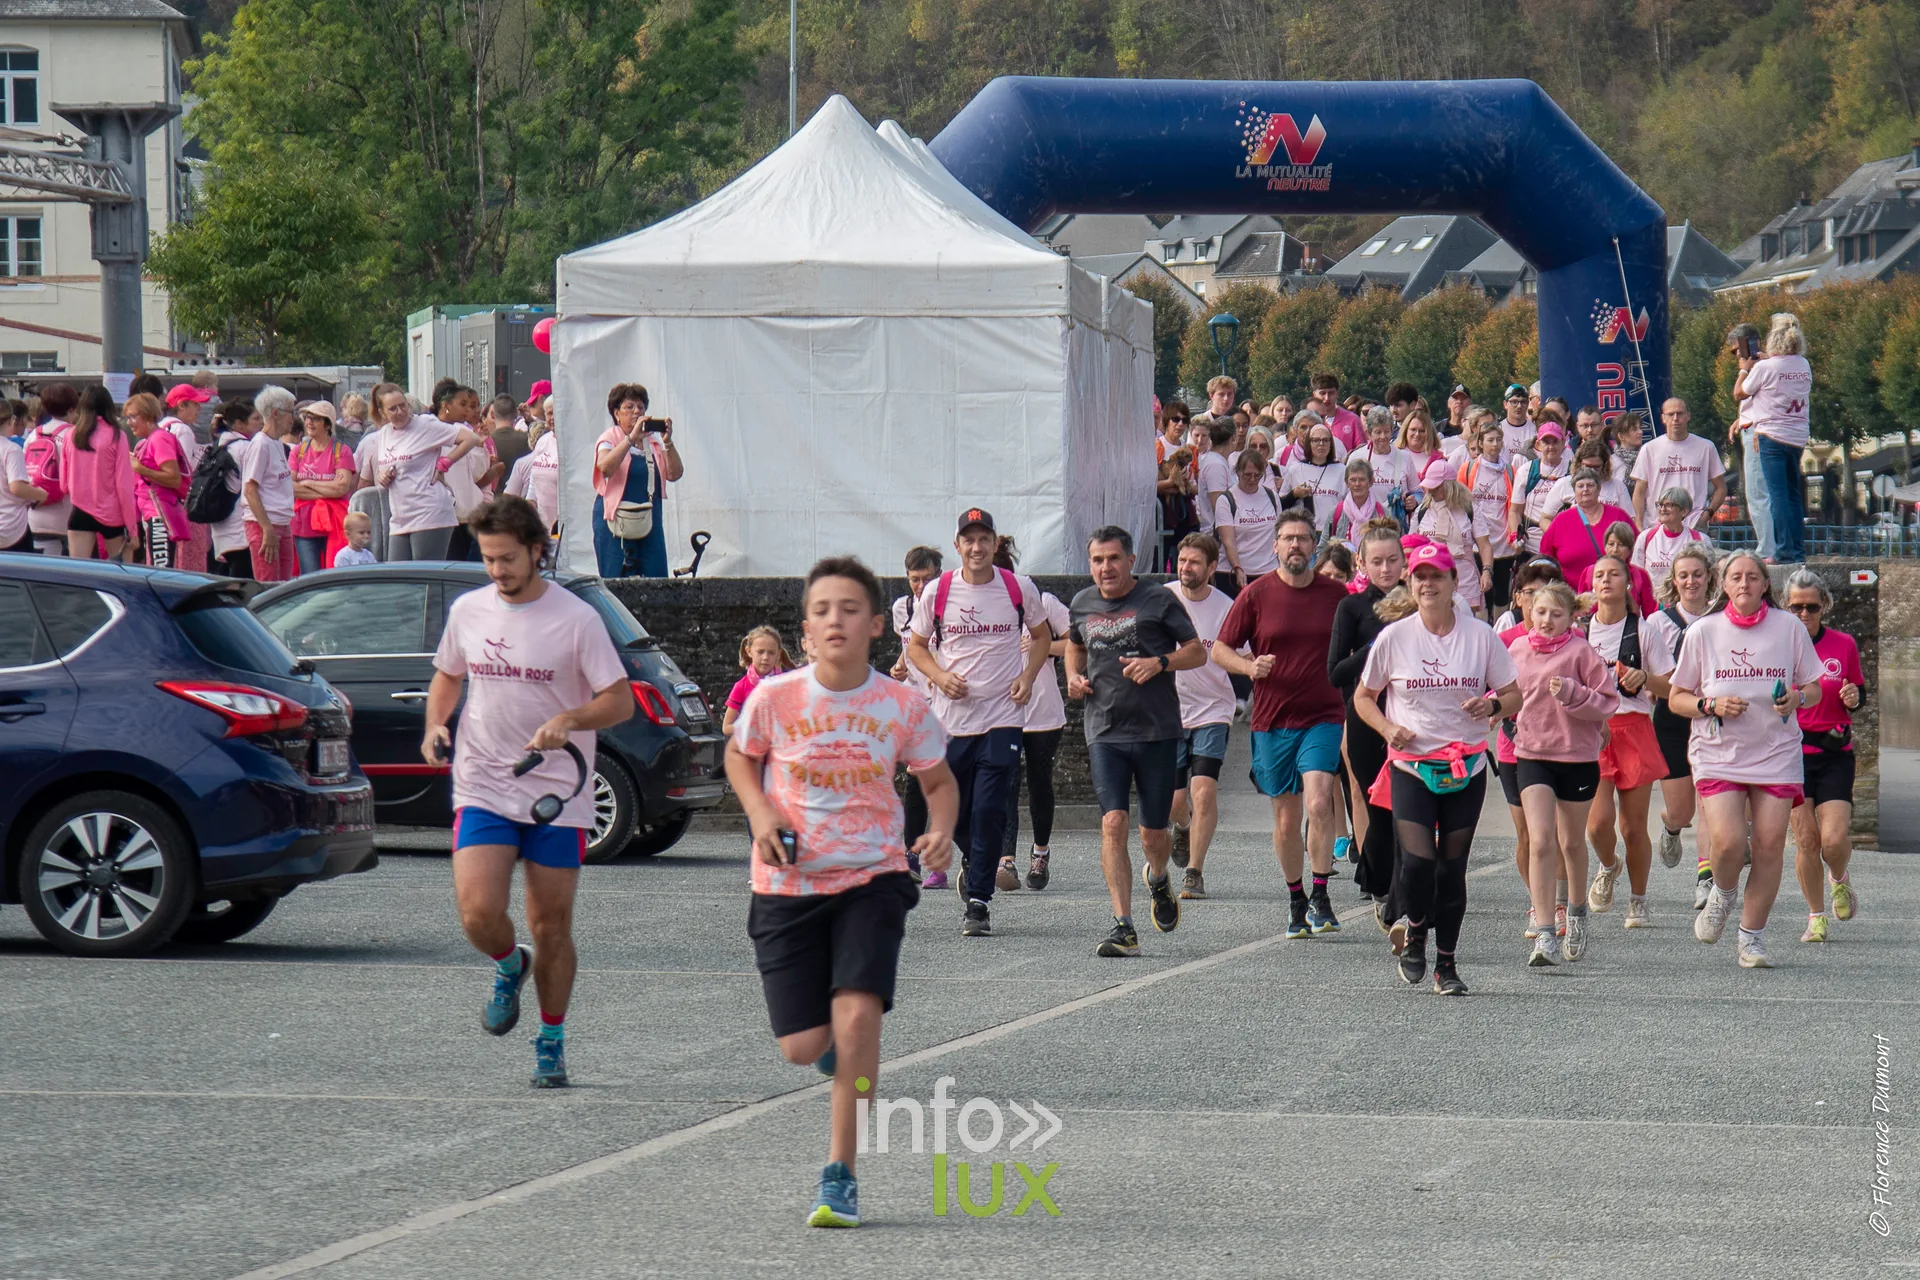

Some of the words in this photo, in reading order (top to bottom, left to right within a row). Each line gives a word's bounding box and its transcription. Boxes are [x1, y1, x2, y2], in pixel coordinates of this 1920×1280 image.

[1234, 164, 1253, 179] LA
[1256, 162, 1334, 179] MUTUALITÉ
[1628, 360, 1651, 396] LA
[1659, 465, 1688, 474] BOUILLON
[525, 667, 556, 682] ROSE
[1715, 667, 1763, 679] BOUILLON
[1766, 667, 1787, 679] ROSE
[1406, 677, 1459, 690] BOUILLON
[1461, 676, 1480, 688] ROSE
[785, 714, 837, 742] FULL
[845, 713, 896, 743] TIME
[788, 760, 886, 788] VACATION
